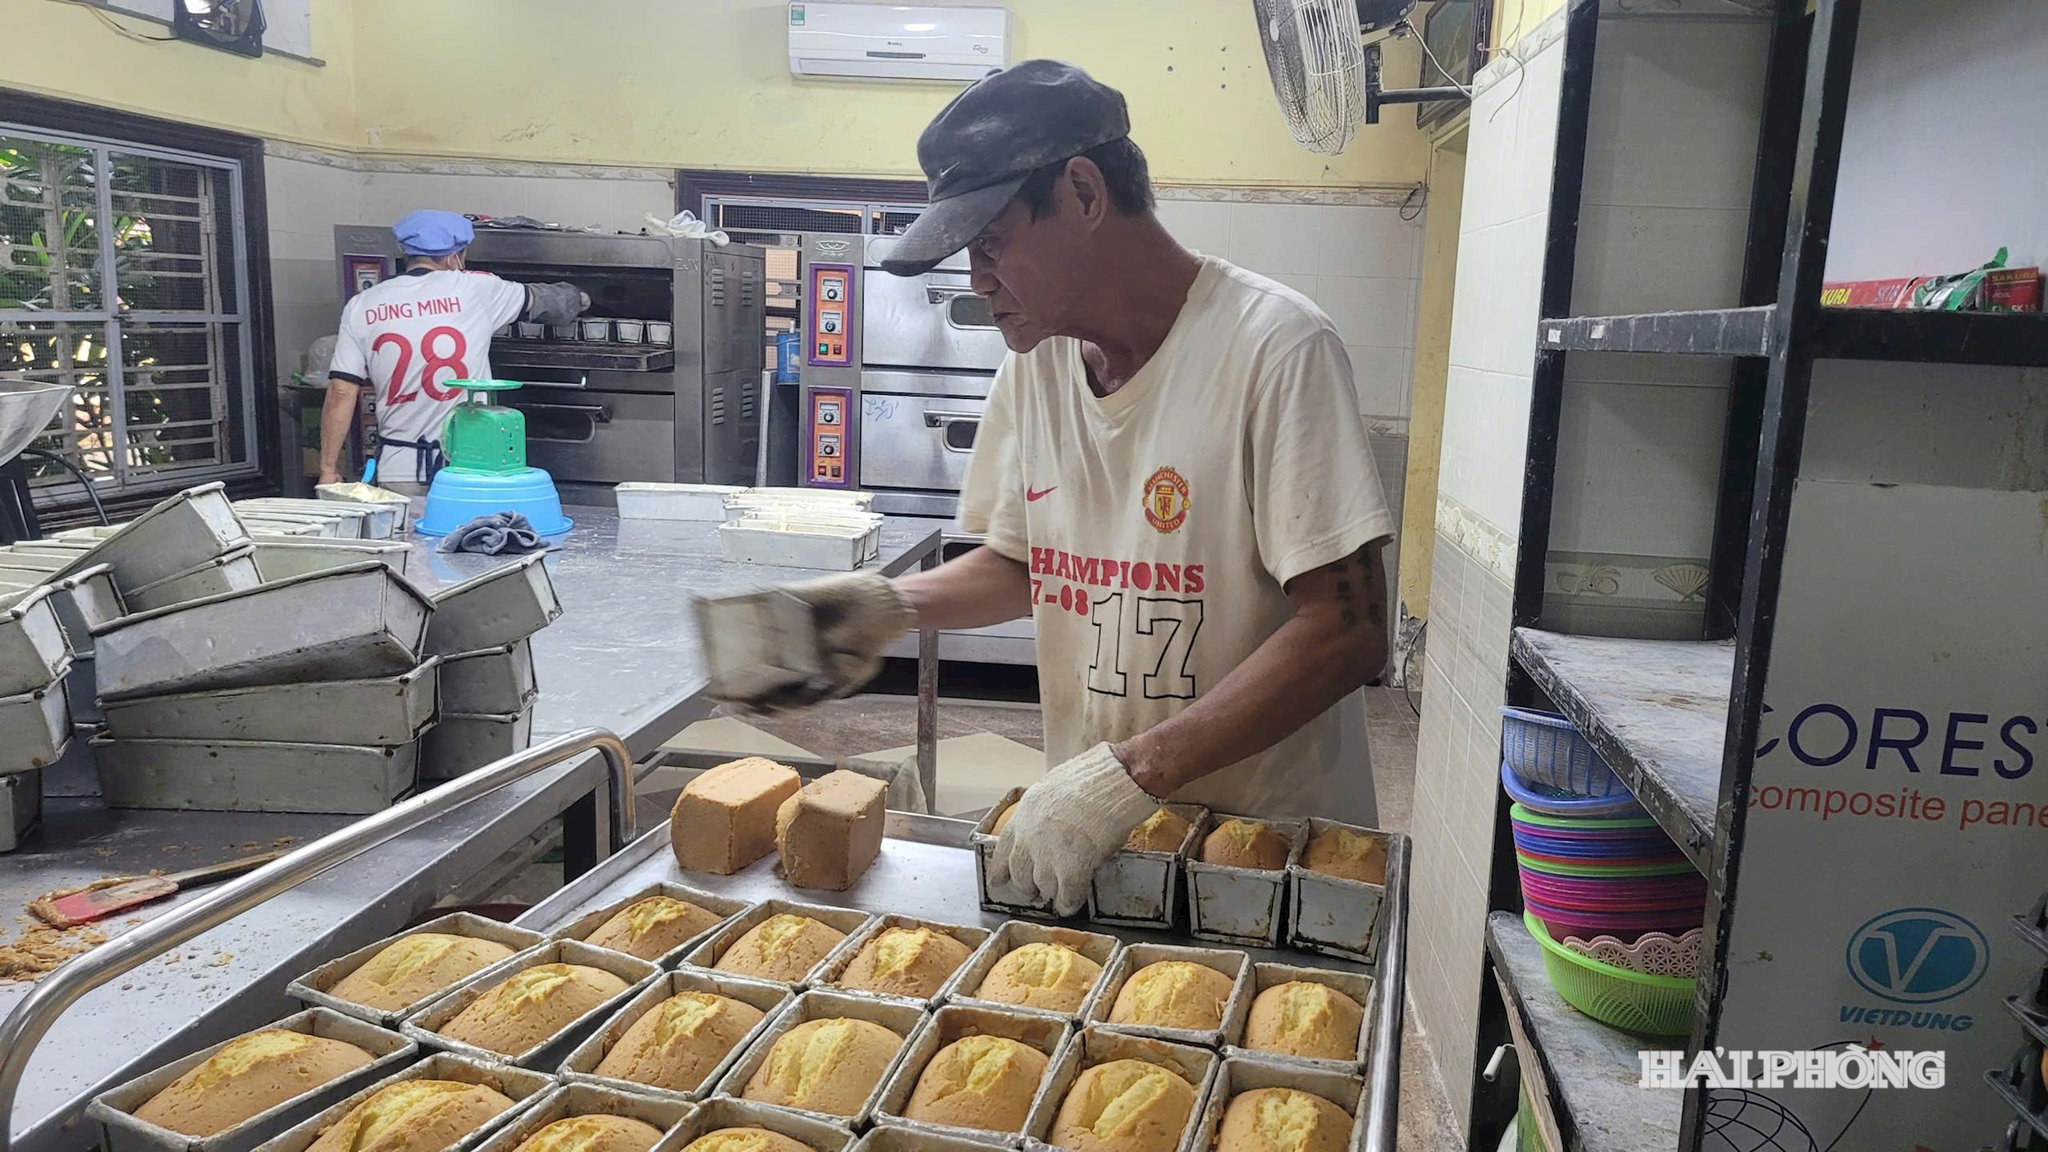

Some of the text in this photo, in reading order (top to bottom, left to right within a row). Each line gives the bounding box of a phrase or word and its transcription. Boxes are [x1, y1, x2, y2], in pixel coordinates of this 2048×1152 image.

[365, 297, 461, 325] DŨNG MINH
[372, 326, 469, 406] 28
[1031, 547, 1205, 593] HAMPIONS
[1087, 592, 1204, 698] 17
[1756, 703, 2048, 780] ORES
[1839, 1004, 1974, 1032] VIETDUNG
